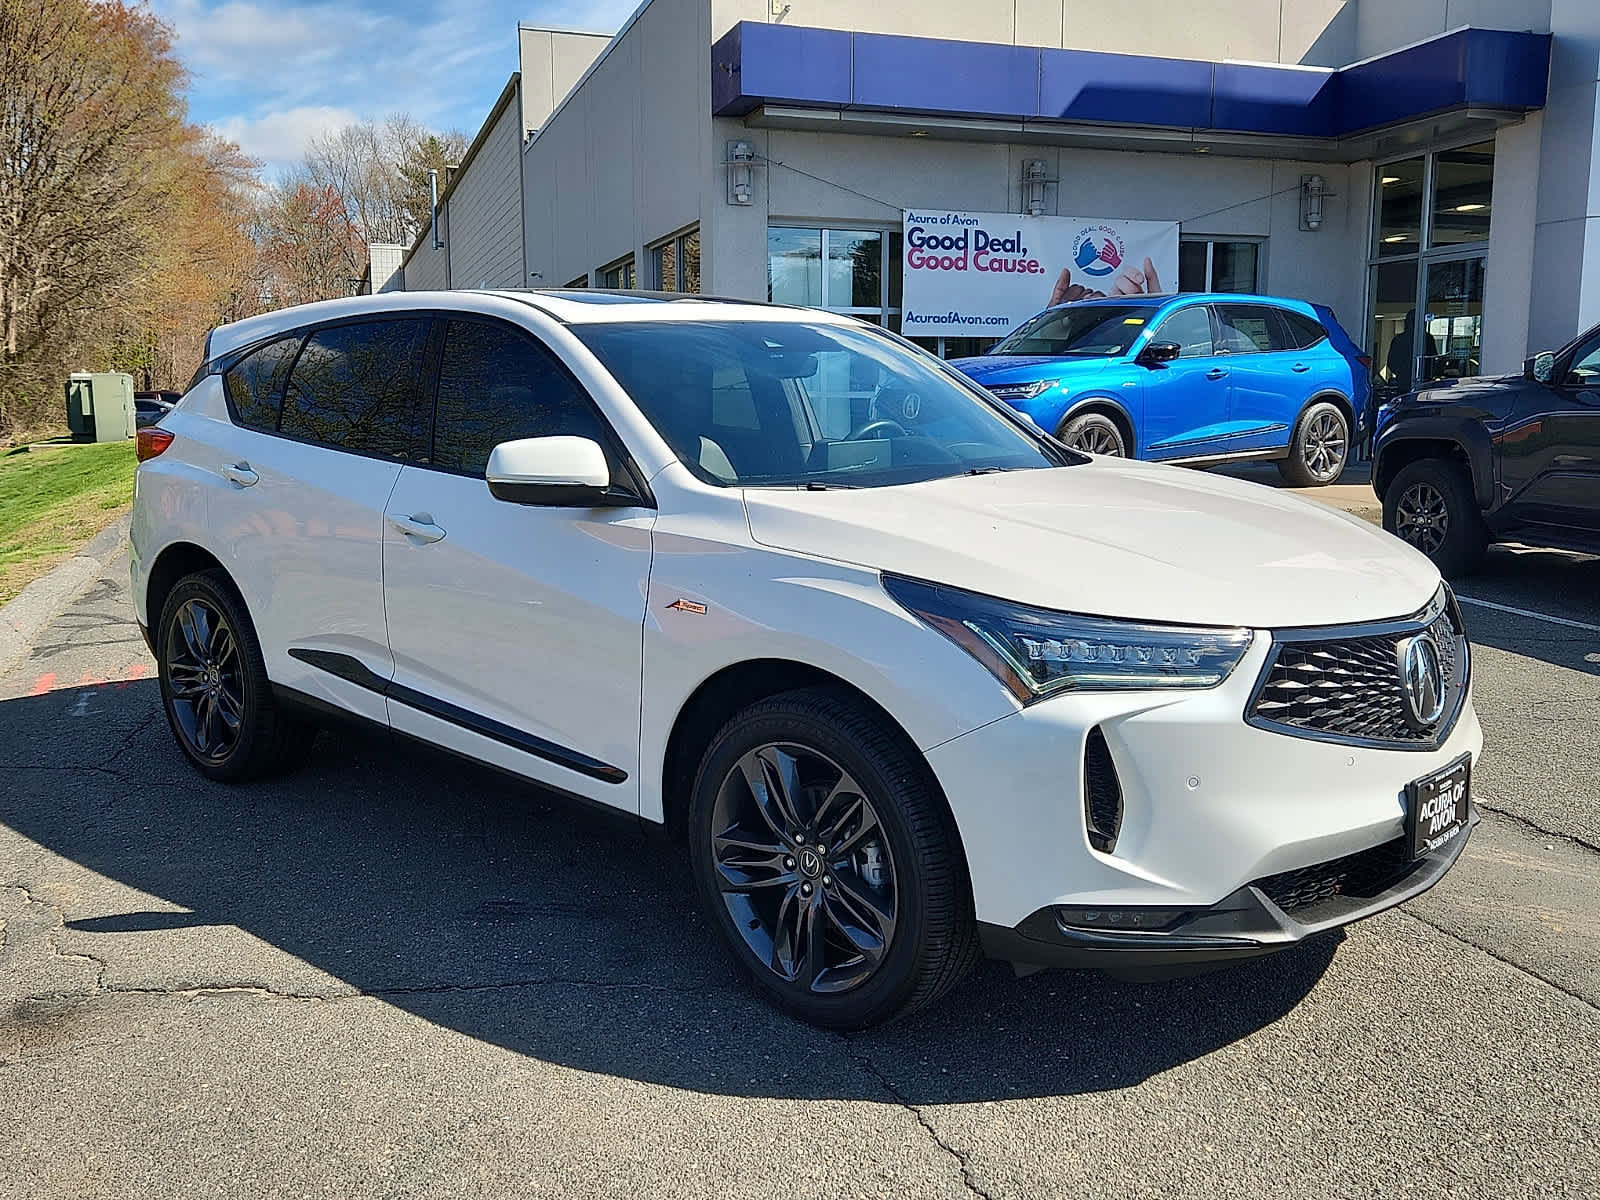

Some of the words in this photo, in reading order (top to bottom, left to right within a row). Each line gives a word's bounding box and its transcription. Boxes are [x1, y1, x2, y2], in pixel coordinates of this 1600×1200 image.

[907, 212, 938, 225] Acura
[940, 214, 951, 225] of
[952, 215, 979, 226] Avon
[908, 226, 969, 251] Good
[974, 229, 1028, 258] Deal,
[907, 247, 969, 271] Good
[973, 249, 1046, 274] Cause.
[905, 311, 1010, 325] AcuraofAvon.com
[1420, 790, 1453, 823] ACURA
[1453, 780, 1465, 803] OF
[1429, 804, 1456, 835] AVON
